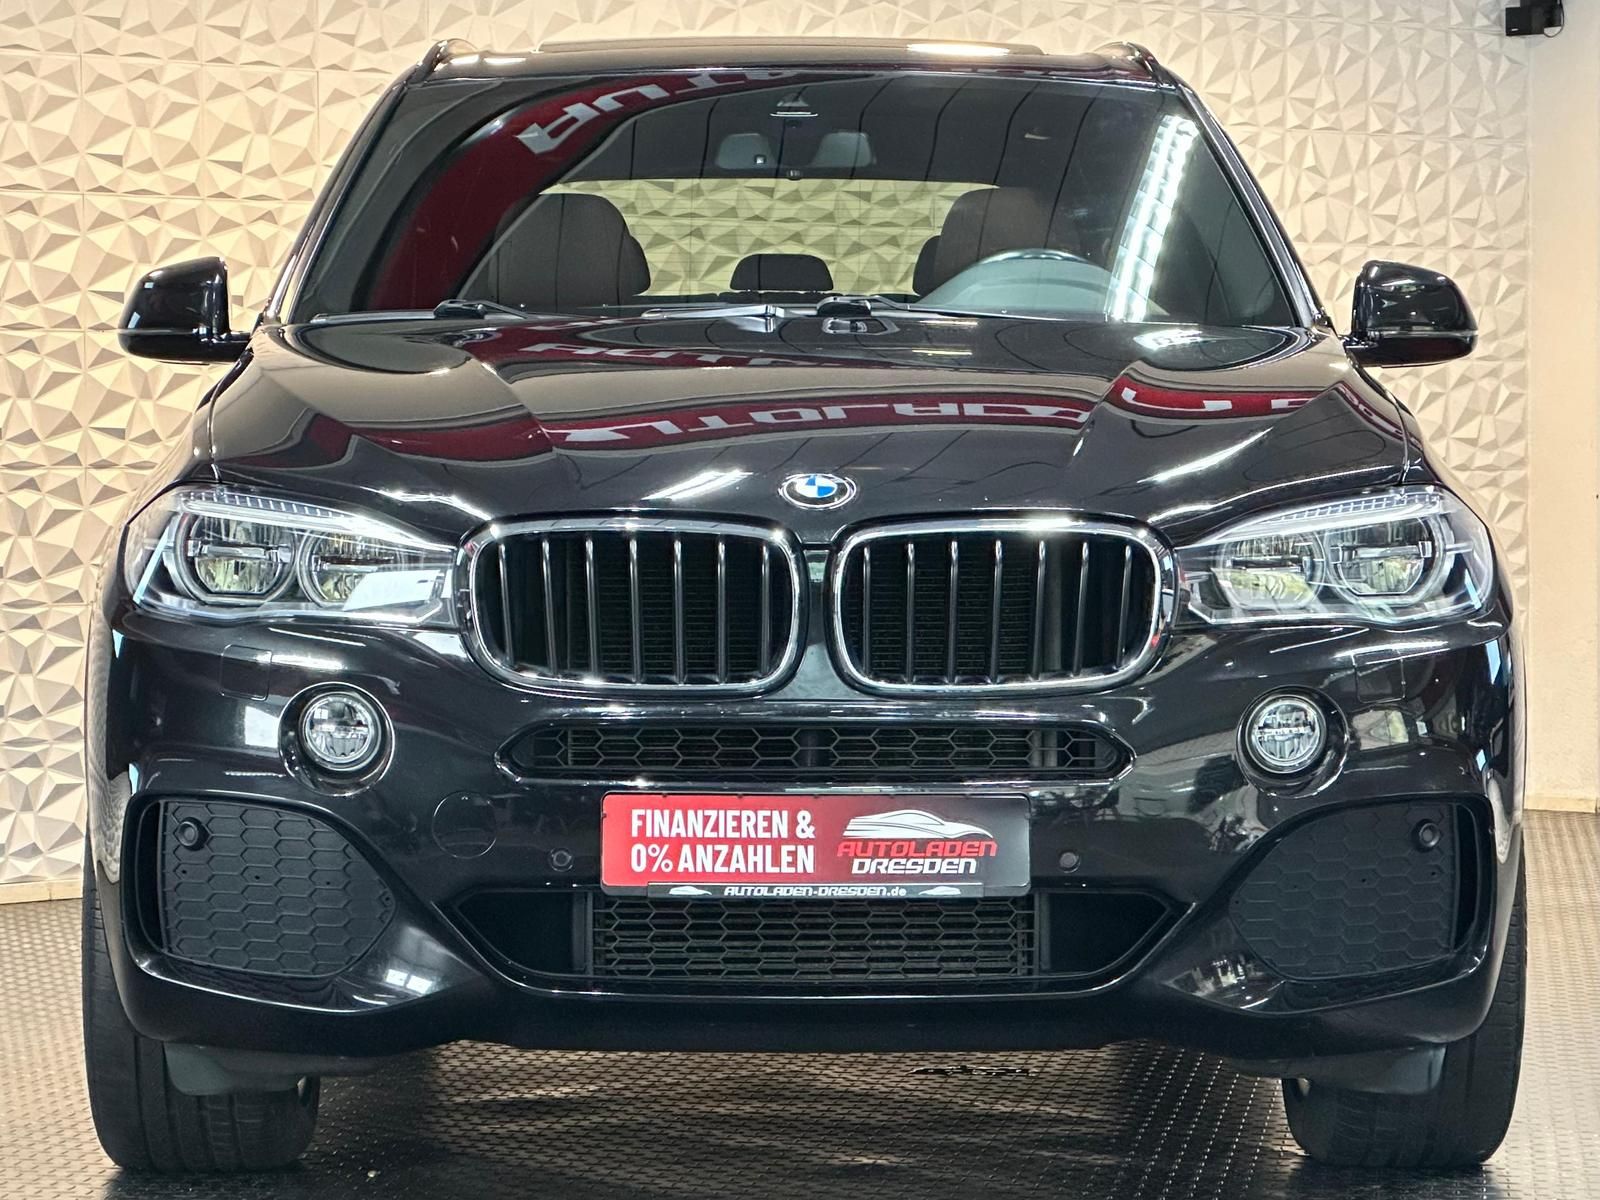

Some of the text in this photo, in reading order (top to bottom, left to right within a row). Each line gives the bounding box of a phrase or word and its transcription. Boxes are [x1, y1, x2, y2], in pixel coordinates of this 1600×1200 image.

[631, 809, 815, 838] FINANZIEREN &
[837, 840, 998, 857] AUTOLADEN
[631, 844, 814, 873] 0% ANZAHLEN
[851, 858, 977, 874] DRESDEN
[724, 886, 907, 897] AUTOLADEN-DRESDEN.de
